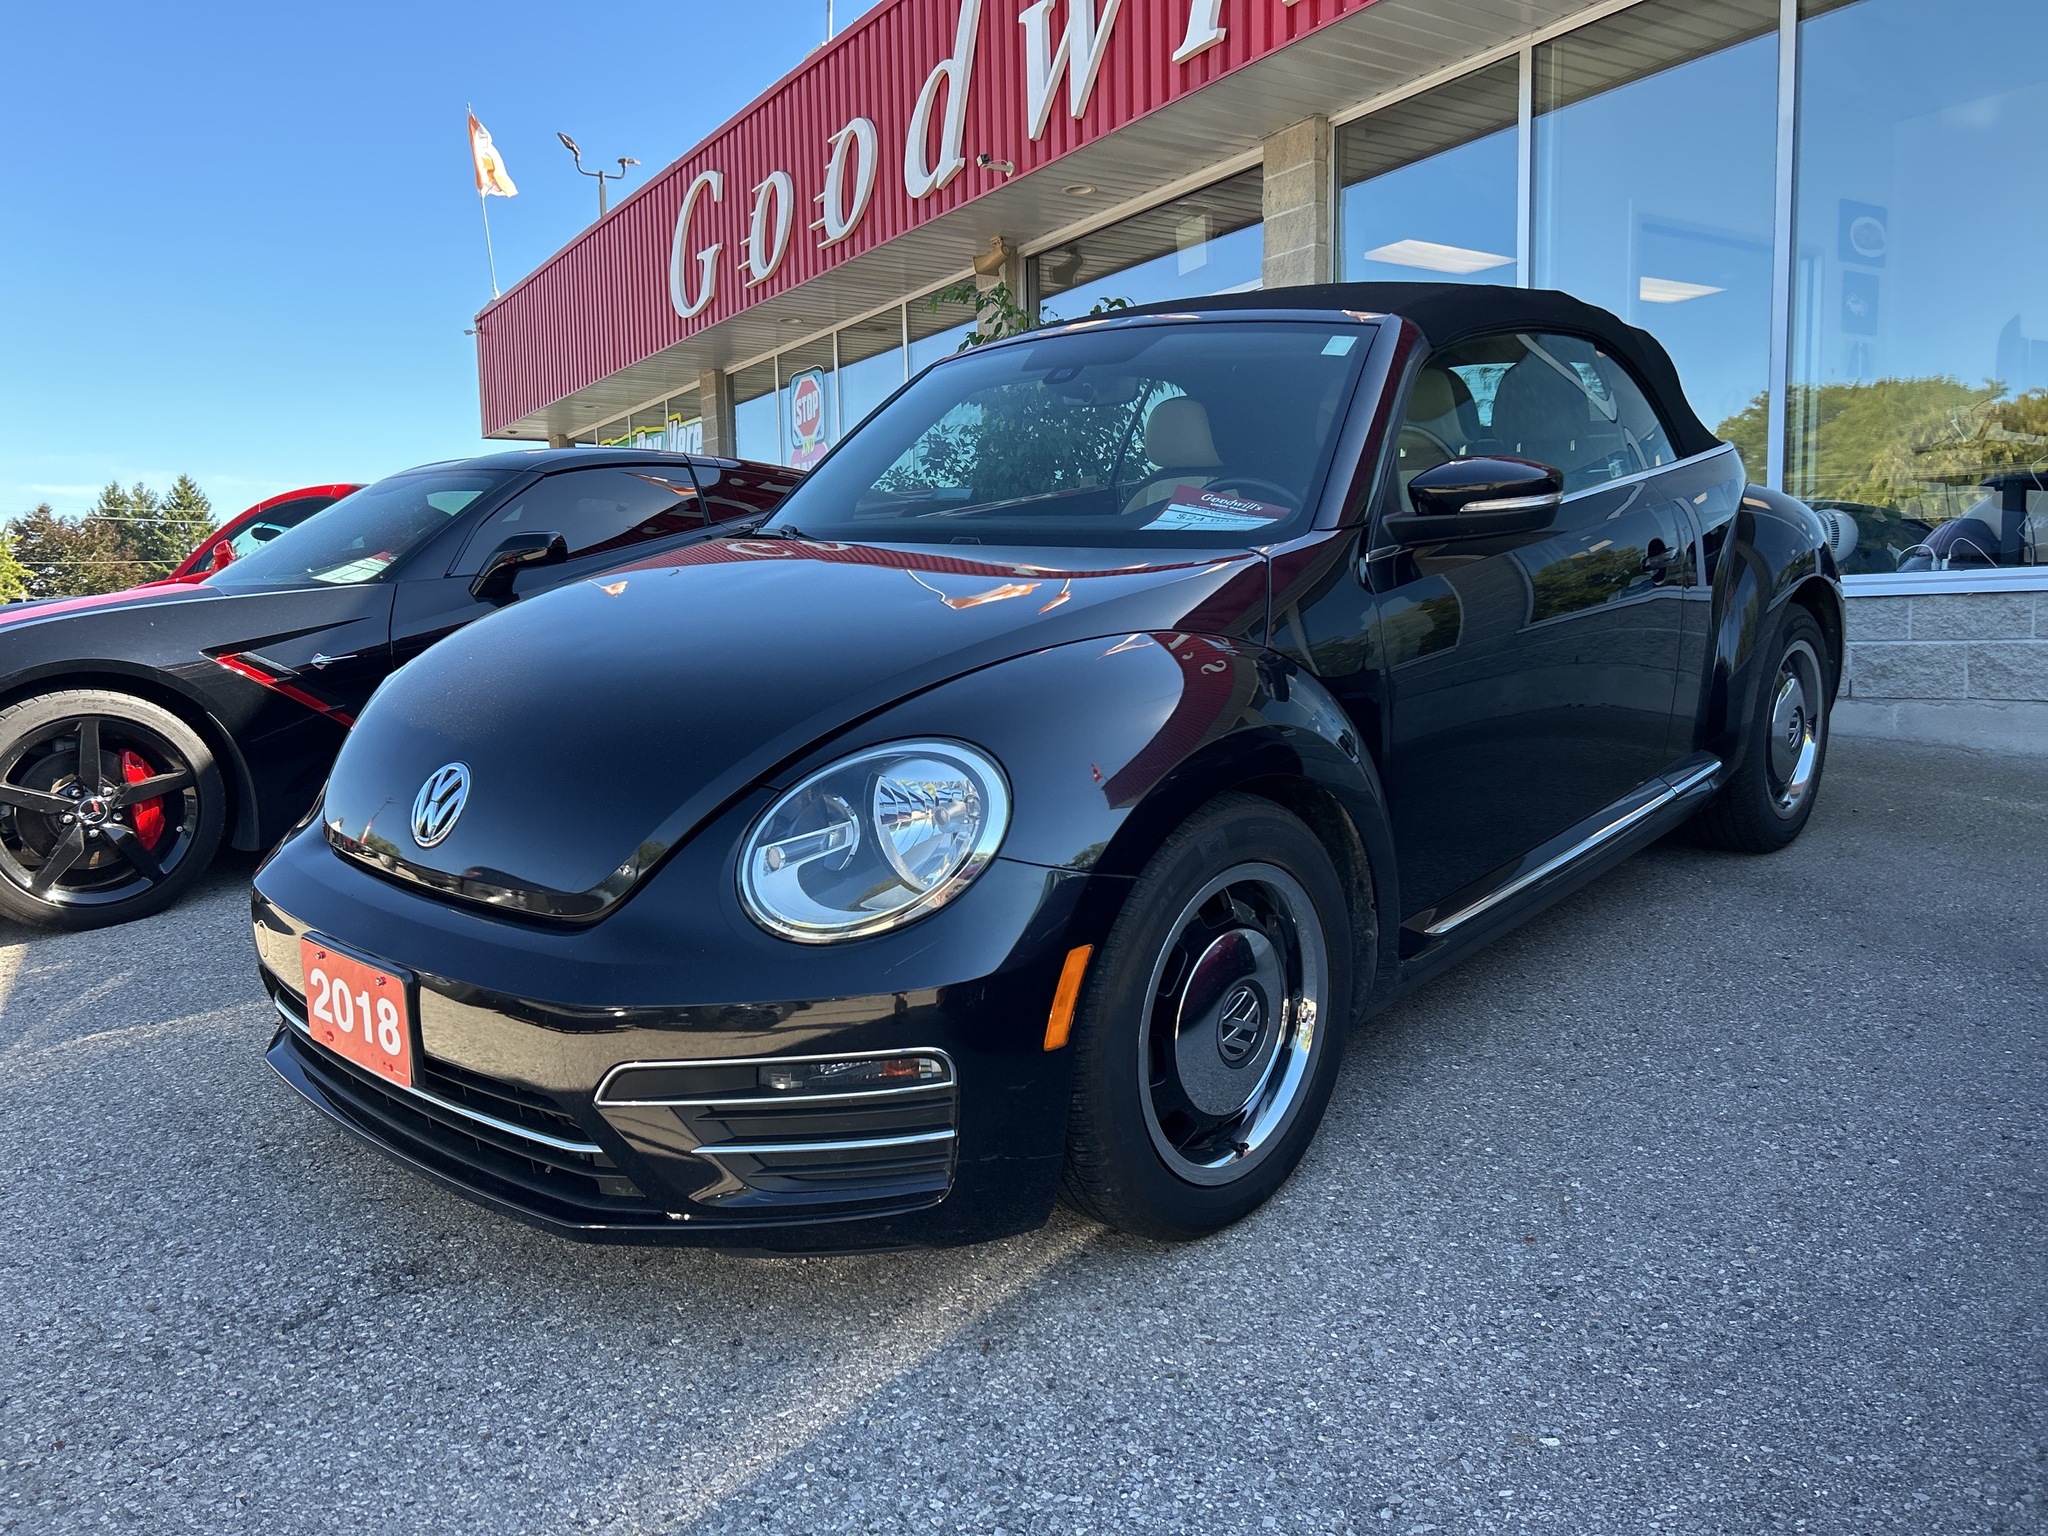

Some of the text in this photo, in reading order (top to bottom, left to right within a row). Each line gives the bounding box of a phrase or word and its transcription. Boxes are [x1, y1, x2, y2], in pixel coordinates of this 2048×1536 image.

[796, 389, 819, 428] STOP
[1201, 493, 1263, 511] Goodwill's
[310, 967, 402, 1056] 2018
